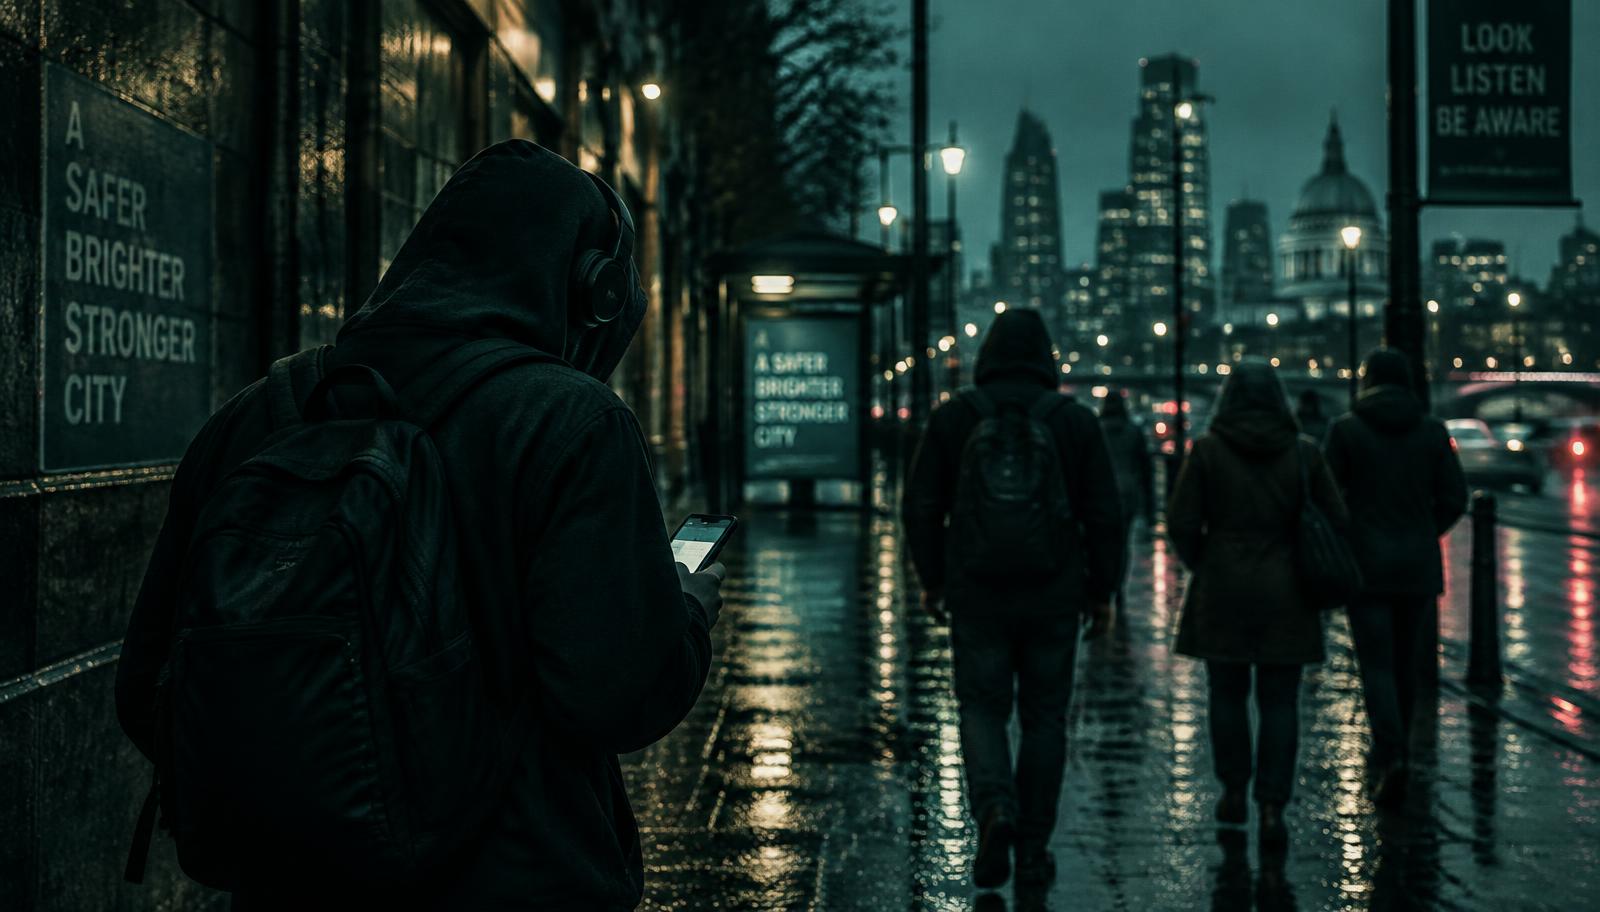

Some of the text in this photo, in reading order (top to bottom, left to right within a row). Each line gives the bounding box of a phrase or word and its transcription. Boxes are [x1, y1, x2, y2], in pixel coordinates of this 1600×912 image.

[1460, 22, 1534, 54] LOOK
[1450, 63, 1546, 96] LISTEN
[65, 100, 84, 150] A
[1435, 104, 1562, 137] BE AWARE
[66, 161, 147, 231] SAFER
[65, 230, 185, 301] BRIGHTER
[64, 301, 196, 364] STRONGER
[754, 353, 770, 373] A
[64, 373, 127, 424] CITY
